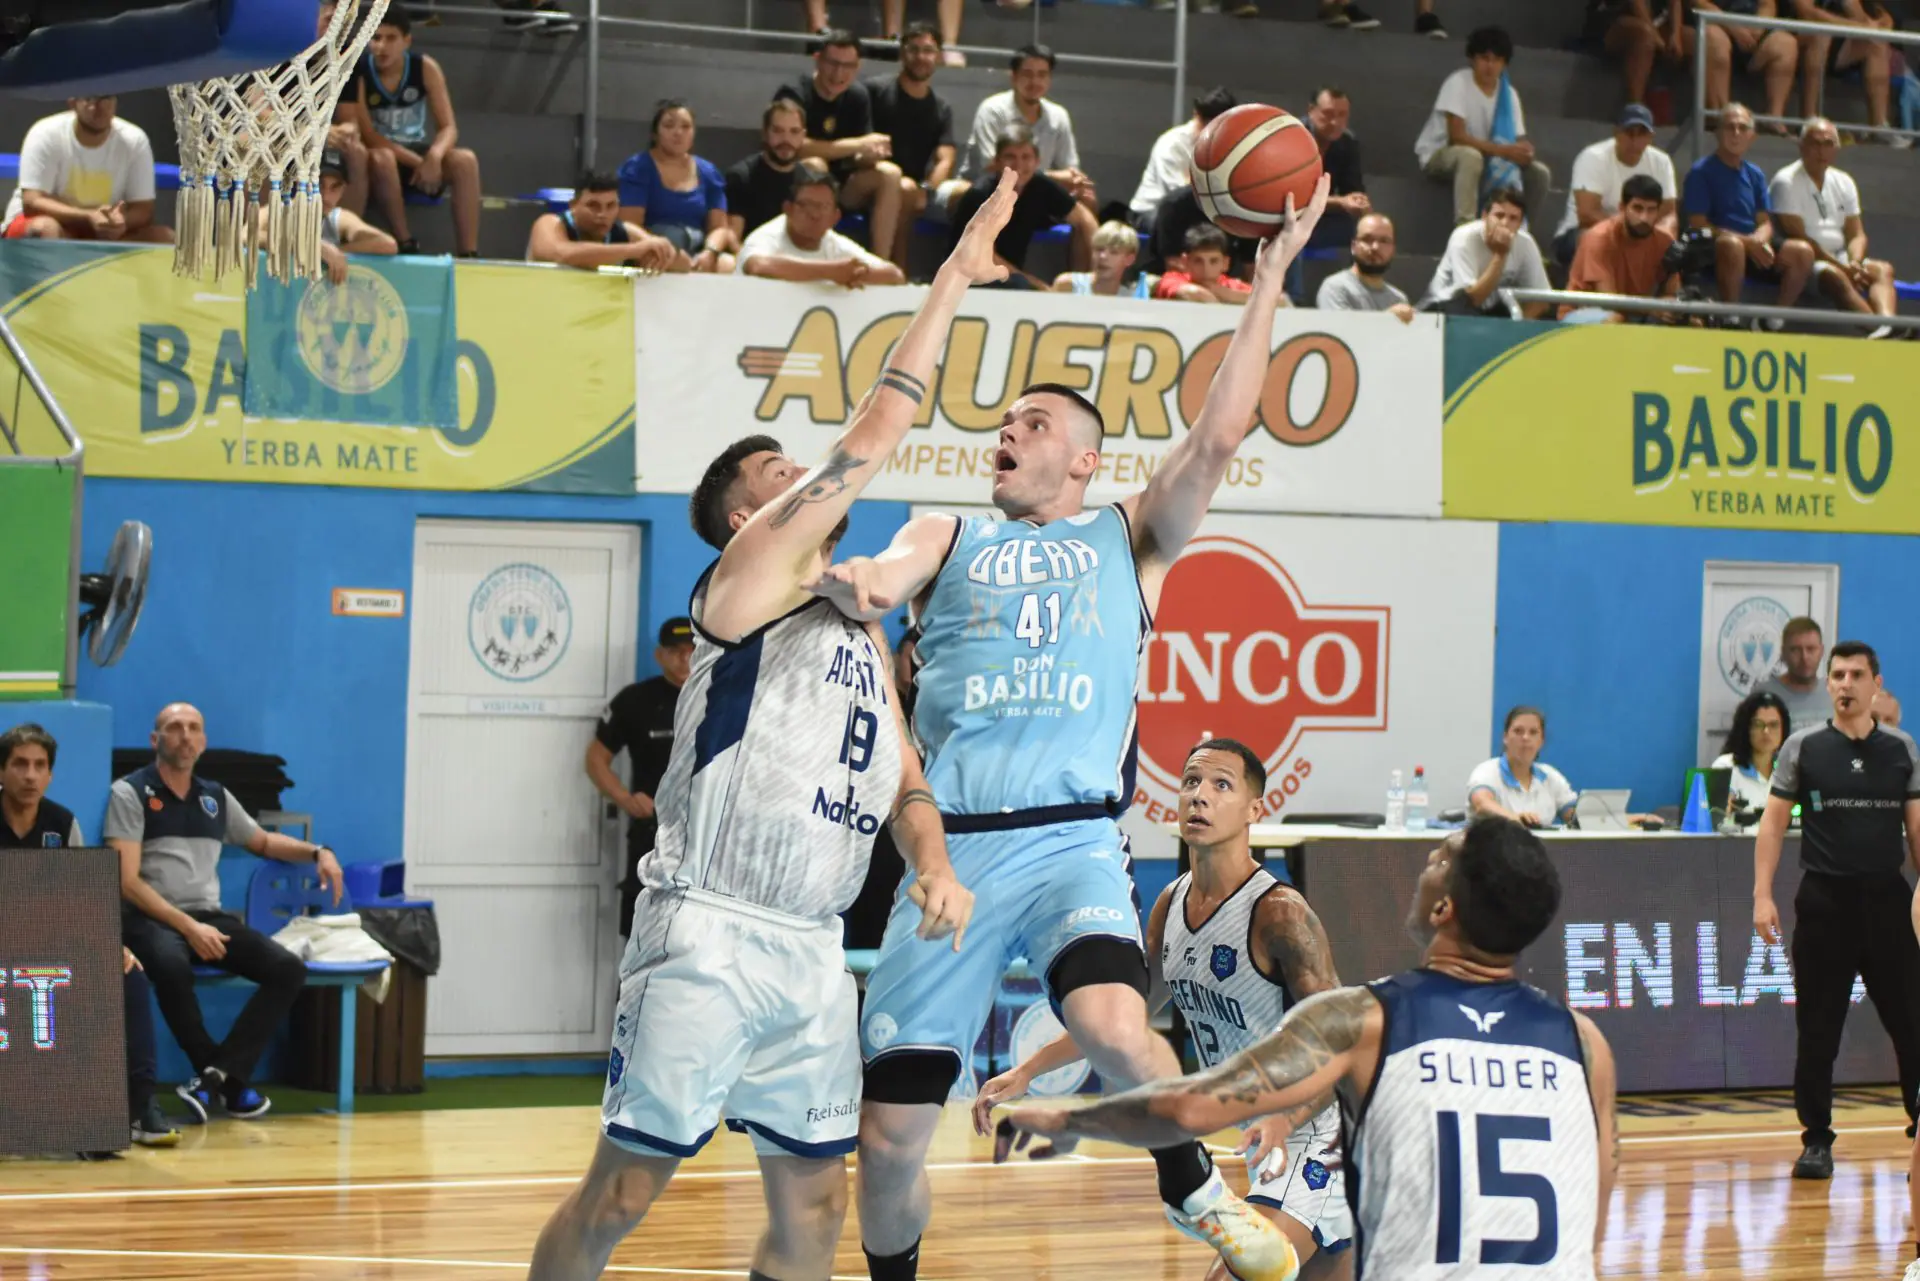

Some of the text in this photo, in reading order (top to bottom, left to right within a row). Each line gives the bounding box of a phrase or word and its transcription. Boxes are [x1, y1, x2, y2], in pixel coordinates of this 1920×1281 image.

[1724, 348, 1807, 395] DON
[222, 438, 418, 472] YERBA MATE
[1633, 391, 1892, 494] BASILIO
[1692, 490, 1835, 517] YERBA MATE
[1015, 592, 1061, 648] 41
[1013, 653, 1057, 675] DON
[1137, 630, 1362, 705] INCO
[964, 671, 1092, 712] BASILIO
[839, 701, 878, 772] 19
[1565, 922, 1796, 1008] EN LA
[1166, 979, 1247, 1030] GENTINO
[1419, 1051, 1558, 1091] SLIDER
[1435, 1110, 1558, 1265] 15
